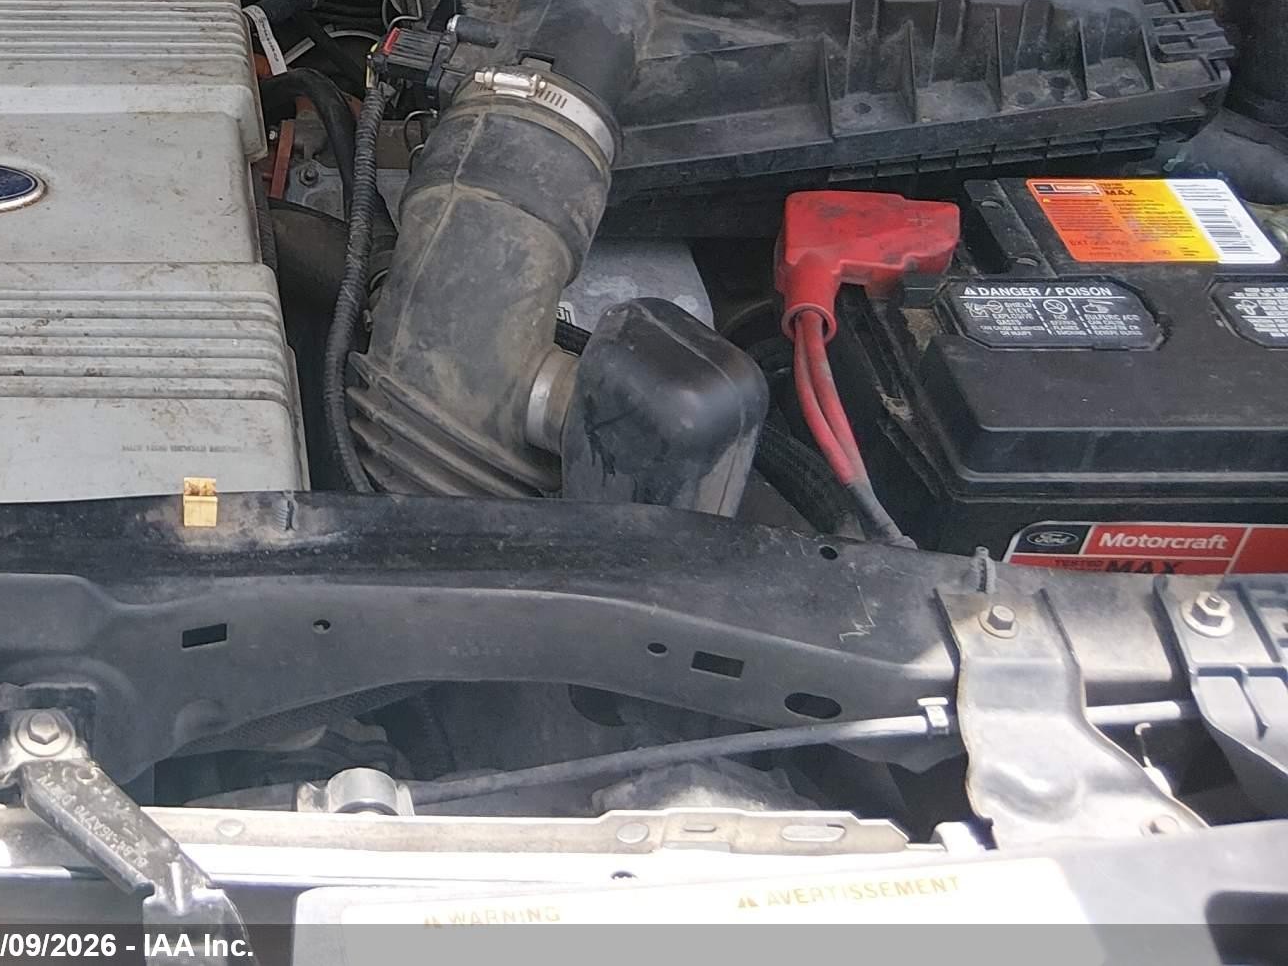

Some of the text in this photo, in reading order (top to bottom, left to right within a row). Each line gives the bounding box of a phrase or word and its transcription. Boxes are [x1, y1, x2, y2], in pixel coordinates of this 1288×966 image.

[977, 287, 1042, 296] DANGER
[1054, 286, 1113, 296] POISON
[1034, 532, 1229, 550] Ford Motorcraft
[1106, 560, 1182, 574] MAX
[766, 874, 962, 908] AVERTISSEMENT
[446, 906, 561, 927] WARNING
